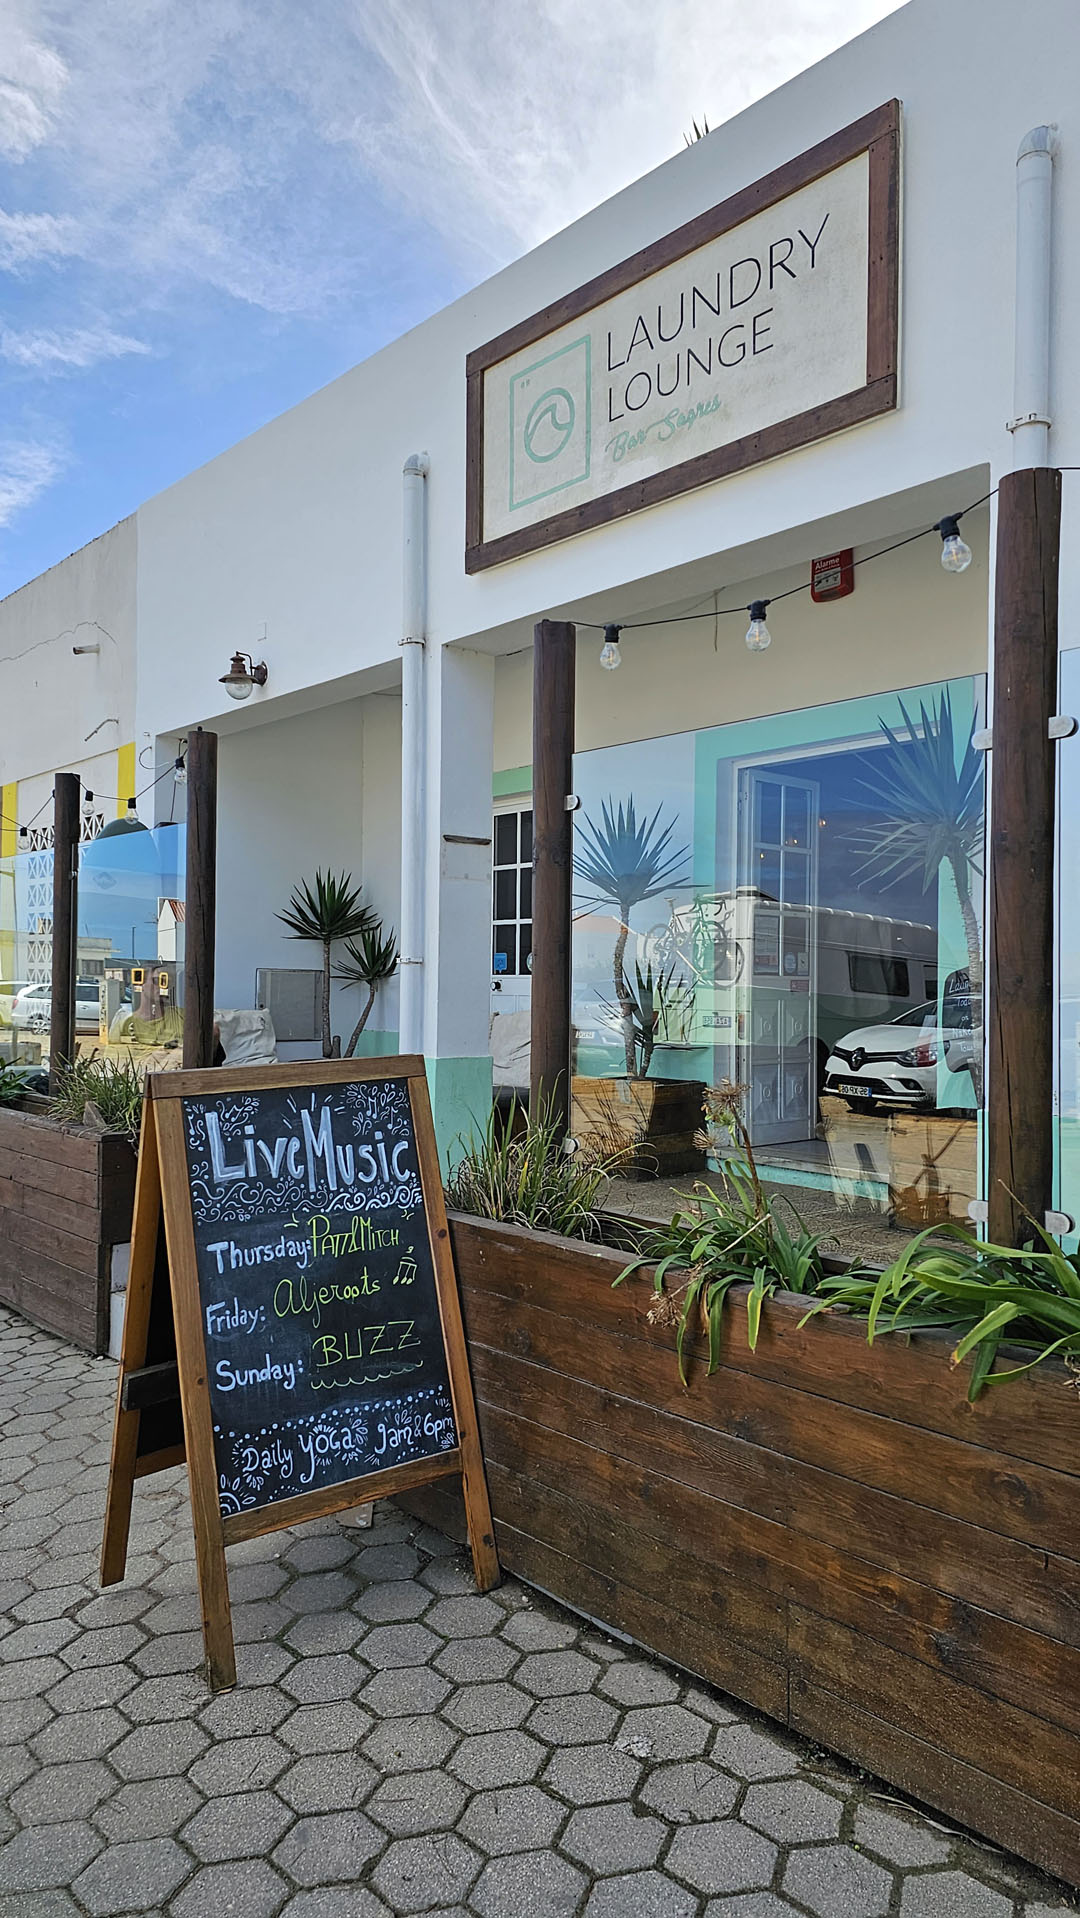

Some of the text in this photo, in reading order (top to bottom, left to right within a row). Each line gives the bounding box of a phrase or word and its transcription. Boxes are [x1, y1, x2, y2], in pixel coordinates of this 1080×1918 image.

[607, 213, 830, 372] LAUNDRY
[608, 307, 774, 423] LOUNGE
[605, 394, 721, 462] Bar Sagres
[815, 558, 840, 571] Alarme
[204, 1105, 411, 1193] Live Music
[206, 1235, 312, 1274] Thursday:
[205, 1297, 266, 1335] Friday:
[215, 1320, 422, 1392] Sunday: BUZZ
[241, 1439, 294, 1479] Daily
[423, 1412, 455, 1443] 6pm
